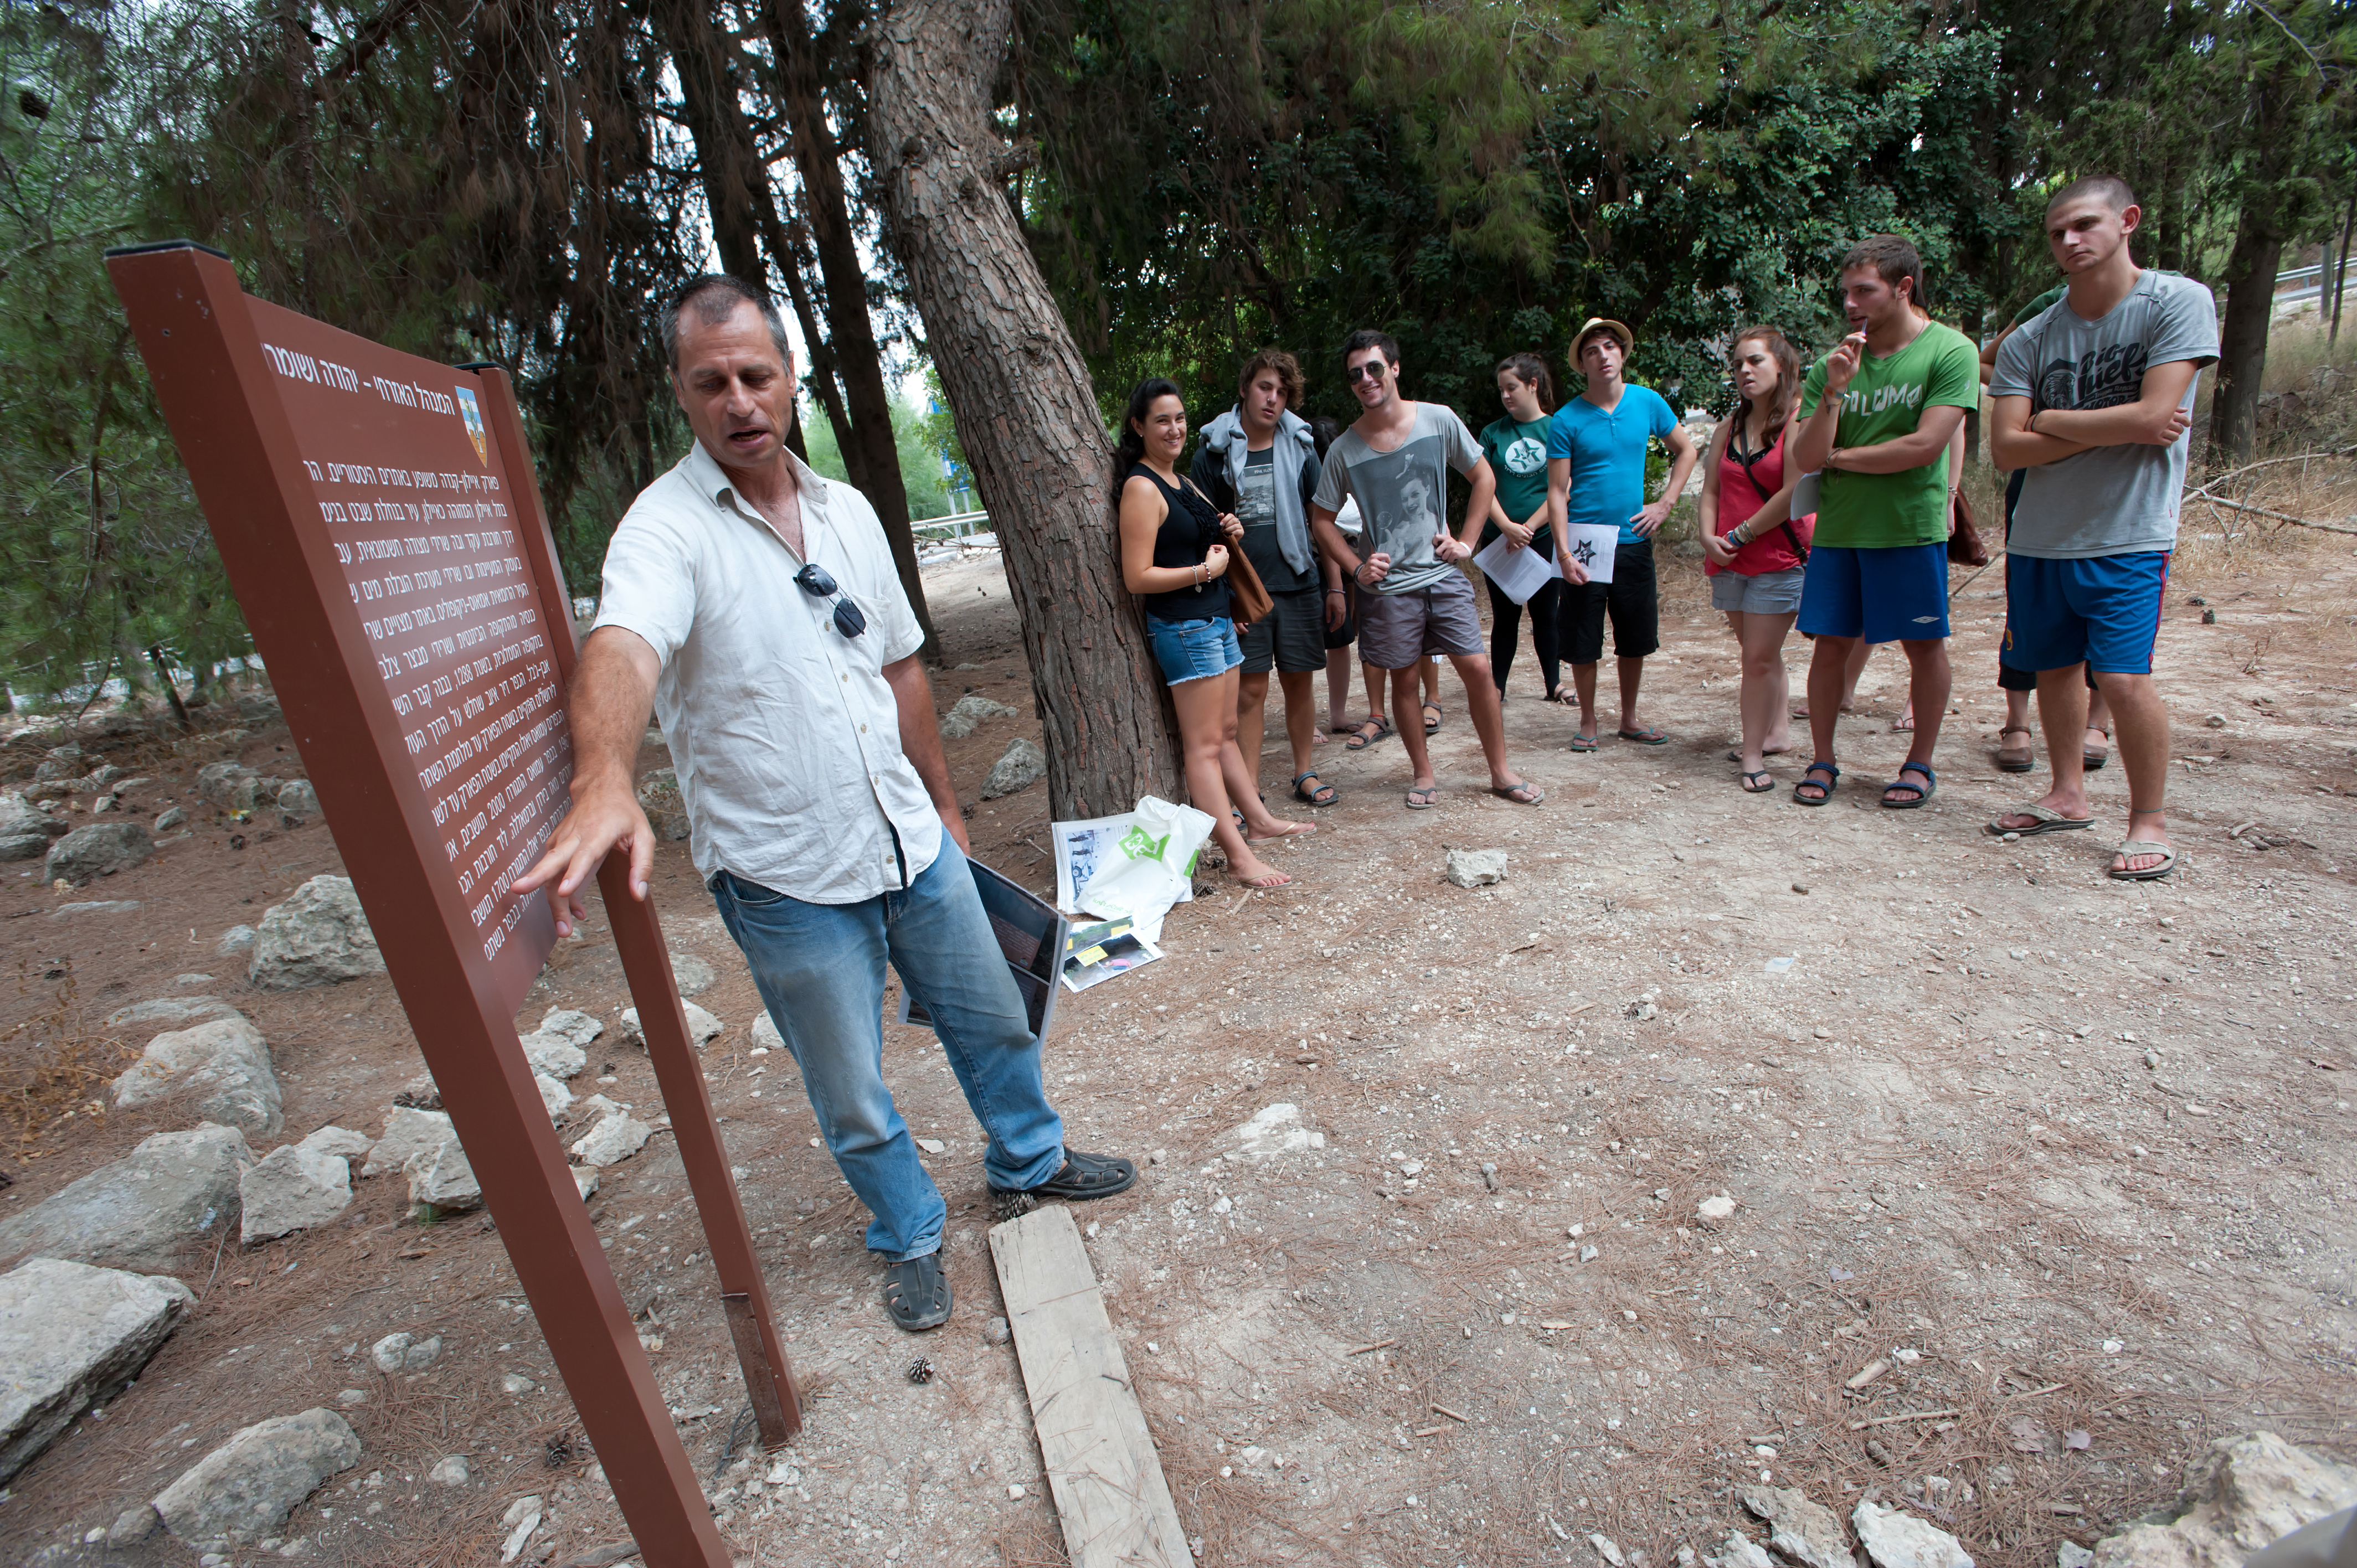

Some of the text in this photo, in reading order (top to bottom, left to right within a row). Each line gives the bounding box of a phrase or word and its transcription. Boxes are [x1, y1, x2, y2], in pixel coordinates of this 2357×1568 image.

[260, 343, 321, 383] ושומר
[2080, 343, 2126, 375] Big
[320, 359, 358, 393] יהודה
[373, 375, 417, 408] האזרחי
[413, 381, 455, 415] המנהל
[303, 460, 500, 494] פארק איילון-קנדה משופע באתרים היסטוריים. הר
[347, 502, 373, 522] שבט
[374, 497, 405, 521] בנחלת
[404, 503, 419, 522] עיר
[421, 498, 446, 525] כאיילון,
[446, 503, 474, 519] המזוהה
[475, 499, 493, 523] איילון
[491, 499, 507, 517] בתל
[334, 530, 514, 565] דרך חורבת עקד ובה שרידי מצודה חשמונאית, עב
[442, 566, 462, 583] שרידי
[475, 560, 503, 577] המעיינות
[503, 556, 522, 576] בעמק
[362, 579, 383, 600] מים
[384, 571, 414, 596] הובלת
[414, 569, 442, 590] מערכת
[514, 583, 529, 599] העיר
[489, 586, 516, 605] הרומאית
[383, 612, 413, 636] מצויים
[411, 607, 436, 627] באתר
[363, 620, 383, 640] שרי
[378, 608, 536, 680] כנסיה מהתקופה הביזנטית ושרידי מבצר צלב
[521, 634, 543, 655] בתקופה
[454, 663, 474, 690] 1288,
[473, 657, 492, 677] בשנת
[433, 675, 452, 697] נבנה
[499, 680, 511, 697] דיר
[510, 672, 526, 690] הכפר
[392, 694, 413, 716] השי
[413, 684, 431, 708] קבר
[485, 687, 500, 706] איוב
[534, 681, 557, 708] לירושלים
[448, 706, 462, 727] על
[463, 695, 485, 719] שחלש
[427, 716, 450, 745] הדרך
[501, 709, 519, 731] בשטח
[545, 709, 564, 731] הכפרים
[470, 734, 482, 752] עד
[480, 720, 503, 751] הפארק
[444, 740, 472, 772] מלחמת
[499, 742, 522, 770] התקיימו
[543, 746, 558, 764] בכפר
[481, 758, 502, 785] בשטח
[458, 773, 484, 810] הפארק
[505, 773, 527, 802] התגוררו
[548, 777, 559, 795] מאז
[447, 791, 460, 813] עד
[487, 792, 506, 820] 2000
[535, 787, 550, 814] בירדן
[460, 811, 488, 852] תושבים,
[509, 800, 537, 840] וברמאללה.
[496, 827, 508, 850] ליד
[537, 822, 551, 844] בכפר
[473, 844, 498, 879] חורבות
[507, 848, 530, 883] התגוררו
[491, 871, 510, 902] 1700
[471, 894, 494, 927] תושבי
[502, 904, 521, 932] בכפר
